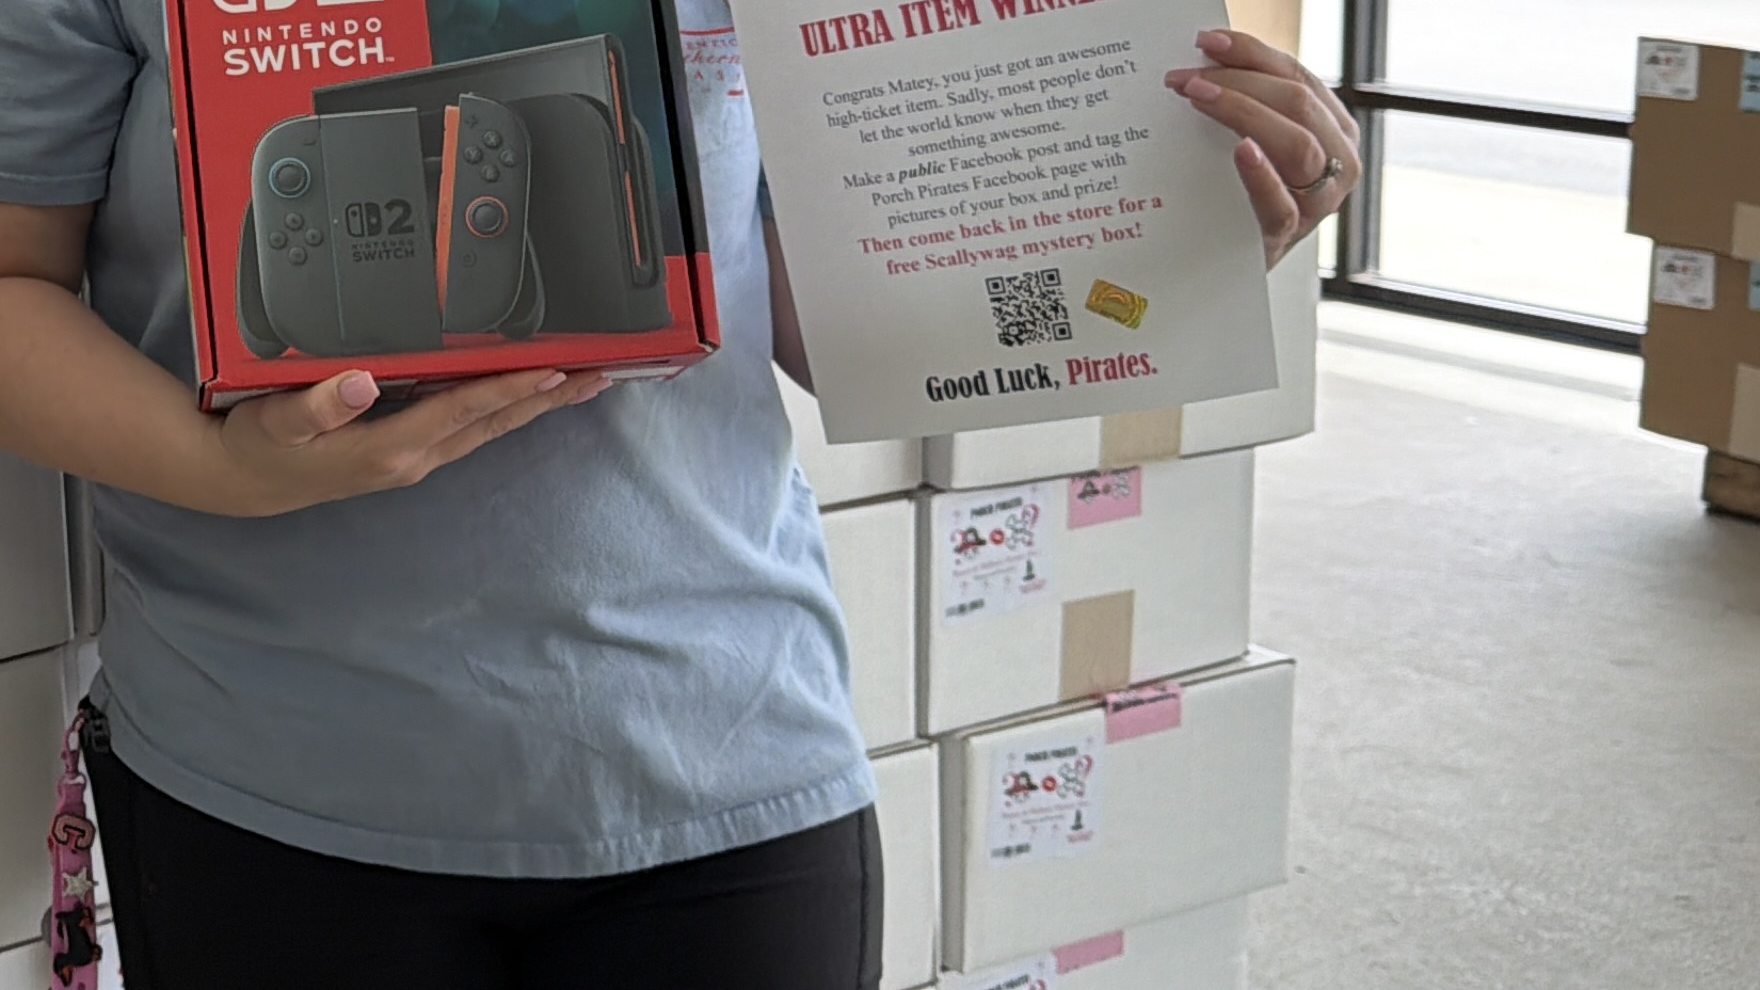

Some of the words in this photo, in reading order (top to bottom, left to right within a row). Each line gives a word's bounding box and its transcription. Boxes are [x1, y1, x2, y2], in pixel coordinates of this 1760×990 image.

[222, 17, 382, 45] NINTENDO
[223, 36, 384, 76] SWITCH
[799, 9, 894, 57] ULTRA
[823, 85, 884, 106] Congrats
[888, 77, 939, 95] Matey,
[942, 70, 971, 88] you
[974, 63, 1003, 82] just
[1006, 59, 1032, 76] got
[1035, 54, 1054, 67] an
[1057, 40, 1132, 64] awesome
[826, 103, 901, 128] high-ticket
[905, 98, 943, 113] item.
[946, 87, 994, 107] Sadly,
[997, 78, 1036, 97] most
[1039, 68, 1092, 93] people
[859, 129, 879, 144] let
[881, 125, 904, 140] the
[907, 115, 952, 134] world
[954, 110, 996, 127] know
[1000, 101, 1042, 119] when
[1046, 95, 1079, 110] they
[1084, 89, 1109, 107] get
[907, 133, 987, 157] something
[990, 120, 1066, 143] awesome.
[842, 172, 883, 189] Make
[886, 172, 895, 183] a
[898, 161, 946, 185] public
[949, 147, 1023, 172] Facebook
[1027, 144, 1060, 162] post
[1064, 134, 1092, 152] and
[1095, 132, 1122, 148] tag
[1124, 126, 1149, 142] the
[872, 188, 915, 206] Porch
[918, 181, 969, 199] Pirates
[972, 165, 1048, 190] Facebook
[1051, 162, 1087, 181] page
[1091, 152, 1127, 169] with
[857, 237, 904, 254] Then
[908, 229, 955, 247] come
[959, 219, 1006, 239] back
[1008, 216, 1028, 232] in
[1033, 211, 1062, 227] the
[1066, 205, 1114, 222] store
[1118, 197, 1147, 214] for
[1151, 196, 1163, 209] a
[888, 208, 946, 229] pictures
[949, 200, 967, 216] of
[970, 197, 1005, 216] your
[1008, 192, 1038, 207] box
[1042, 184, 1071, 201] and
[1073, 175, 1119, 199] prize!
[352, 248, 415, 262] SWITCH
[886, 259, 921, 275] free
[924, 247, 1018, 269] Scallywag
[1022, 233, 1095, 257] mystery
[1101, 222, 1144, 243] box!
[926, 371, 989, 403] Good
[994, 363, 1061, 395] Luck,
[1065, 351, 1159, 387] Pirates.
